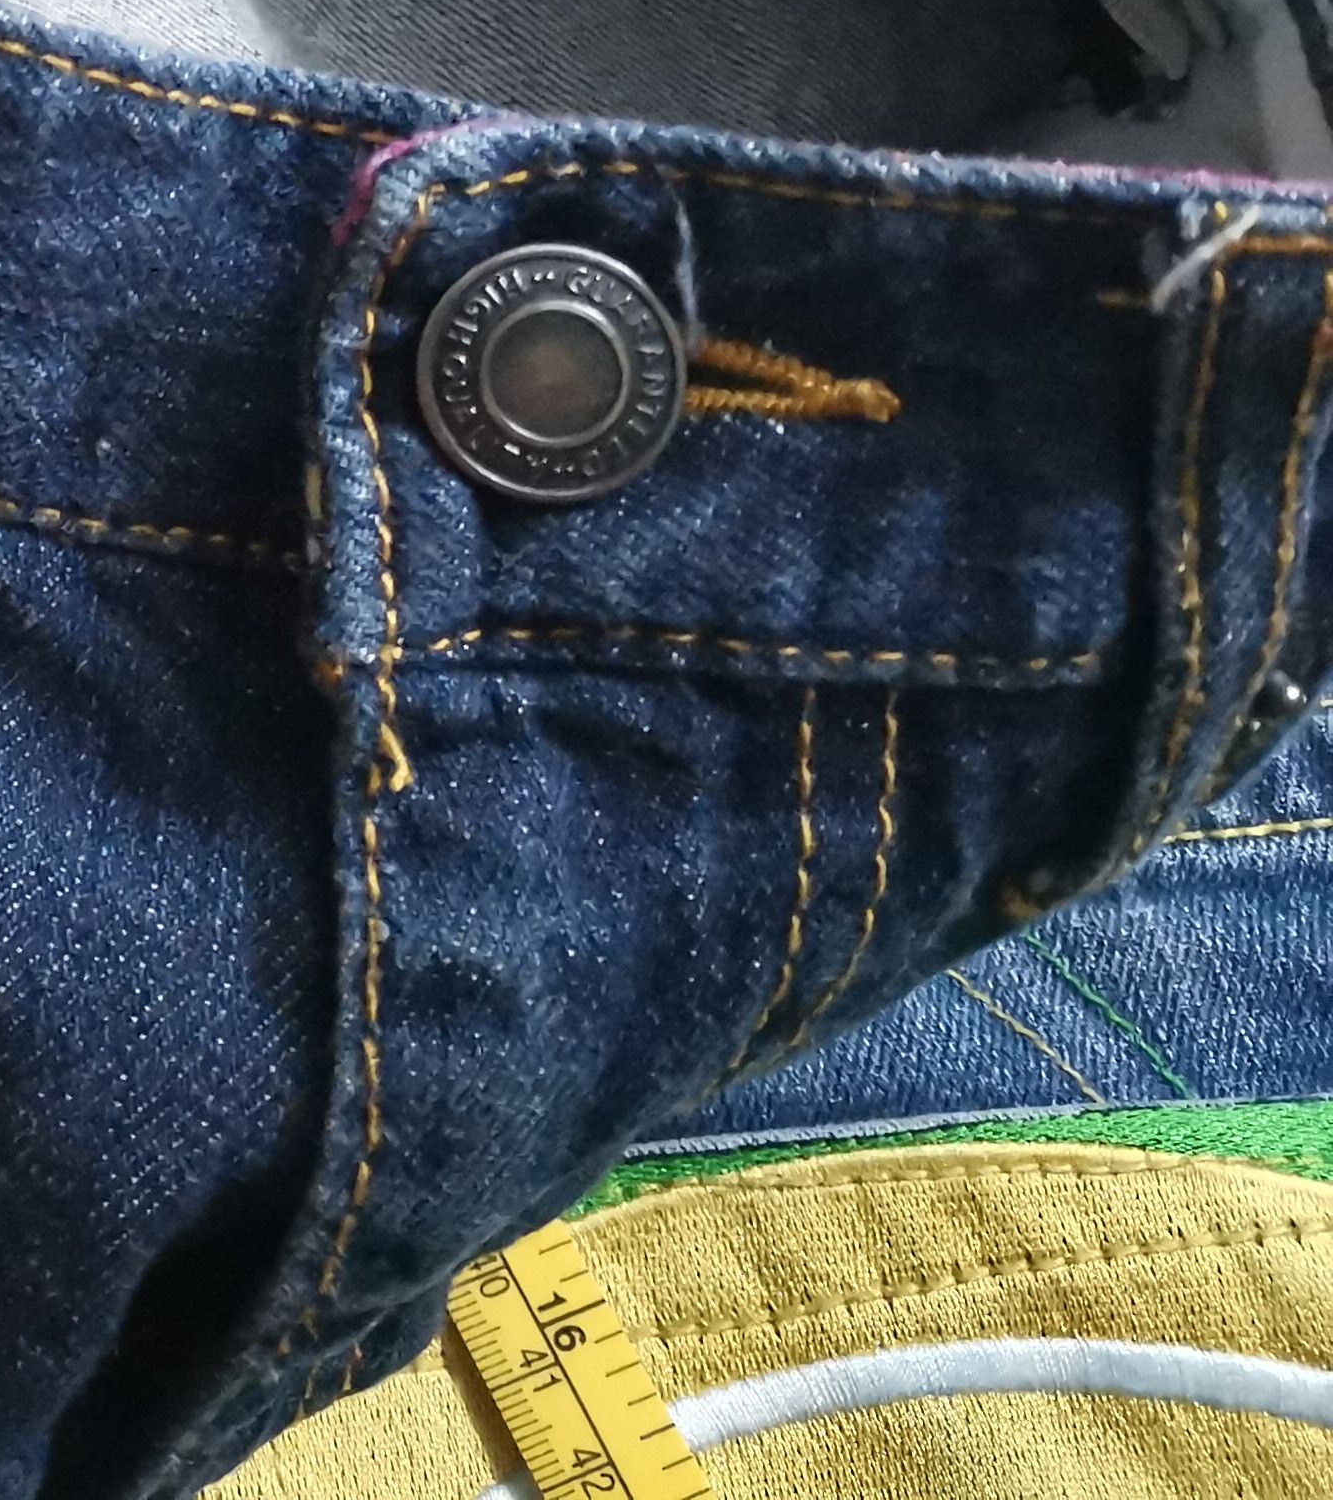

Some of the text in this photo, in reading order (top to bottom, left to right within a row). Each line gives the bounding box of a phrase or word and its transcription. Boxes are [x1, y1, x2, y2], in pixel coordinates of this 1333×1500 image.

[537, 1290, 587, 1352] 16
[519, 1348, 563, 1393] 41
[571, 1448, 616, 1500] 42
